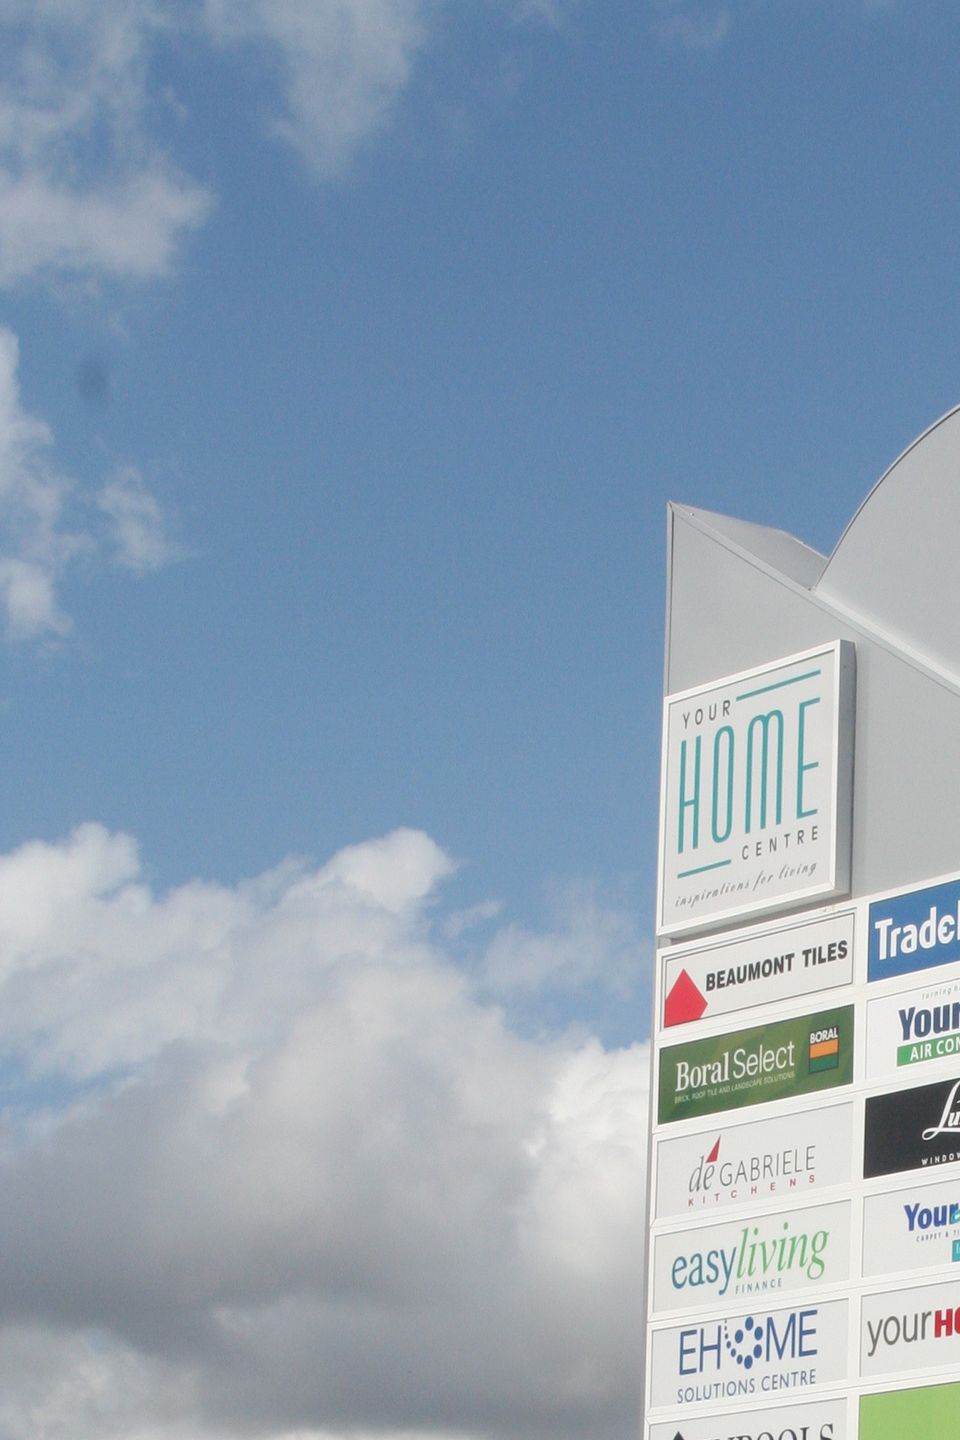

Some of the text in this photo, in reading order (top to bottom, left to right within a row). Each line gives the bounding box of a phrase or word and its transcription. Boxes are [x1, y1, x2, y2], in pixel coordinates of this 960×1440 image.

[682, 699, 731, 729] YOUR
[677, 697, 821, 854] HOME
[741, 825, 819, 861] CENTRE
[752, 870, 774, 891] for
[779, 863, 817, 880] living
[705, 940, 848, 991] BEAUMONT TILES
[809, 1027, 839, 1044] BORAL
[910, 1042, 932, 1061] AIR
[719, 1086, 730, 1094] AND
[688, 1174, 816, 1207] KITCHENS
[735, 1277, 783, 1295] FINANCE
[676, 1368, 816, 1404] SOLUTIONS CENTRE
